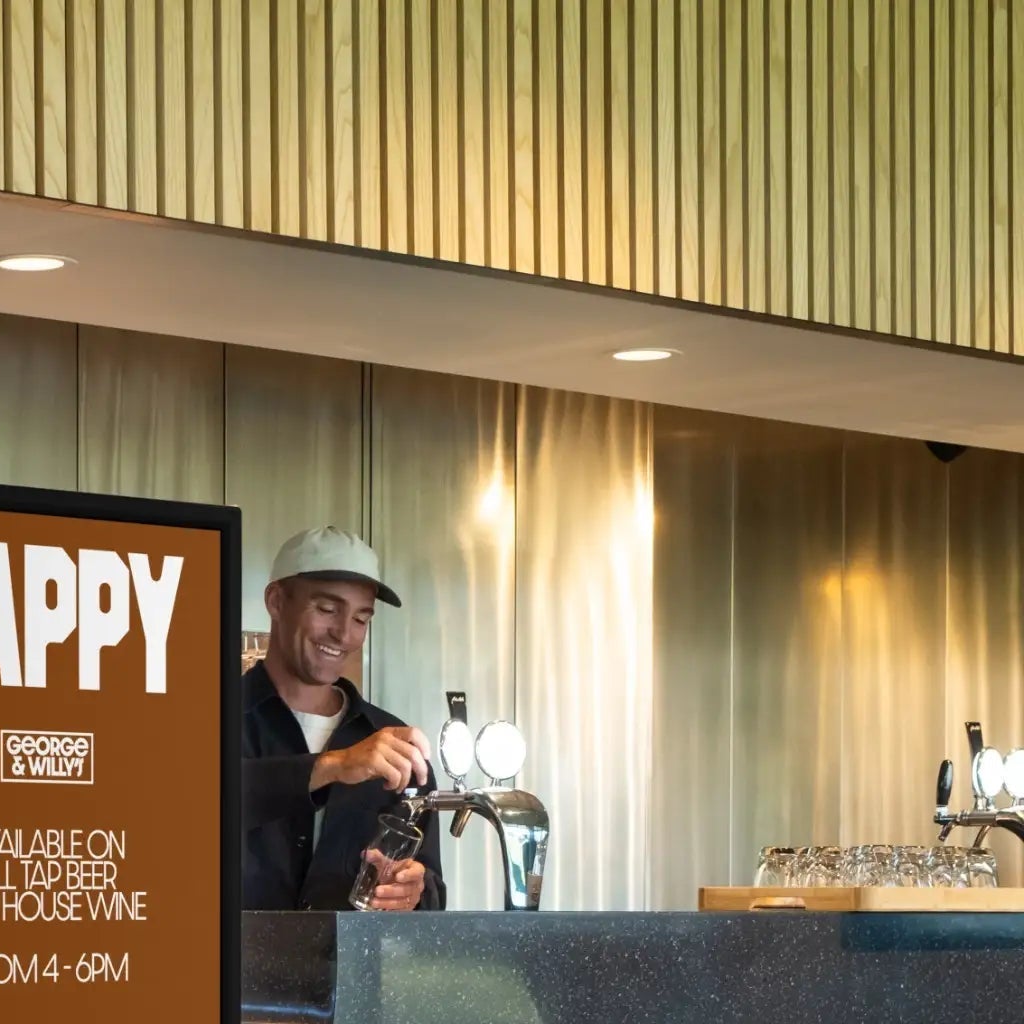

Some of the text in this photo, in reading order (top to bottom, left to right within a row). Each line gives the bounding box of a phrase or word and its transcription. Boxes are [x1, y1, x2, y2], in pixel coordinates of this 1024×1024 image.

[12, 755, 26, 776] &
[87, 829, 126, 860] ON
[20, 860, 62, 890] TAP
[66, 860, 118, 890] BEER
[2, 891, 83, 922] HOUSE
[86, 891, 147, 921] WINE
[42, 953, 60, 983] 4
[75, 952, 129, 983] 6PM
